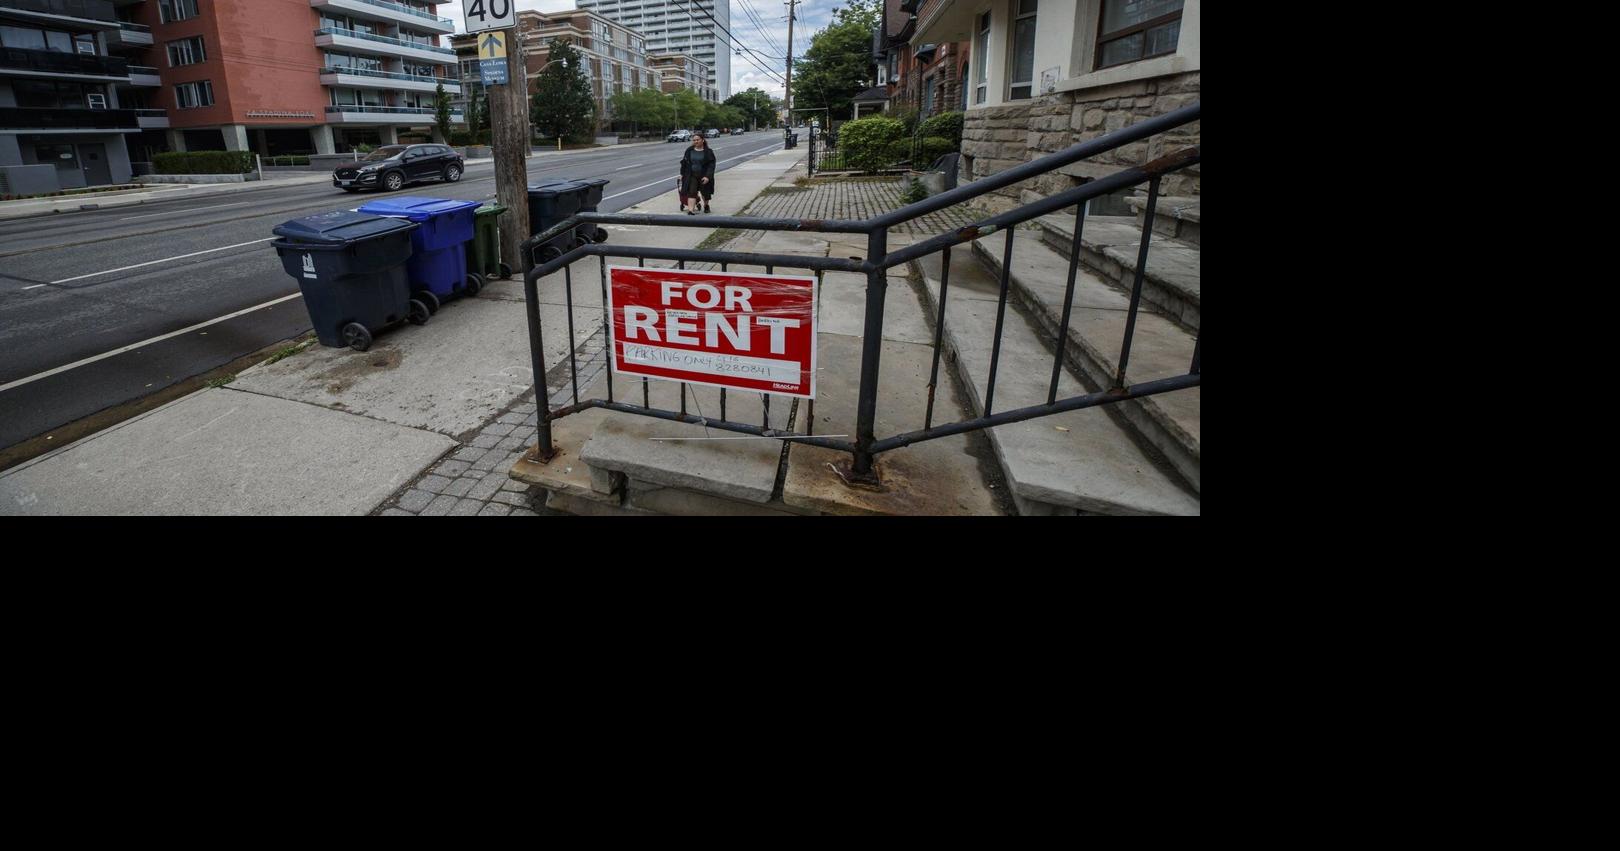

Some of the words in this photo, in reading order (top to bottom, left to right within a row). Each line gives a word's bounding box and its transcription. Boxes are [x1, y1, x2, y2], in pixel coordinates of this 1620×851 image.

[468, 0, 509, 21] 40
[661, 281, 753, 312] FOR
[623, 305, 800, 354] RENT
[625, 344, 681, 362] PARKING
